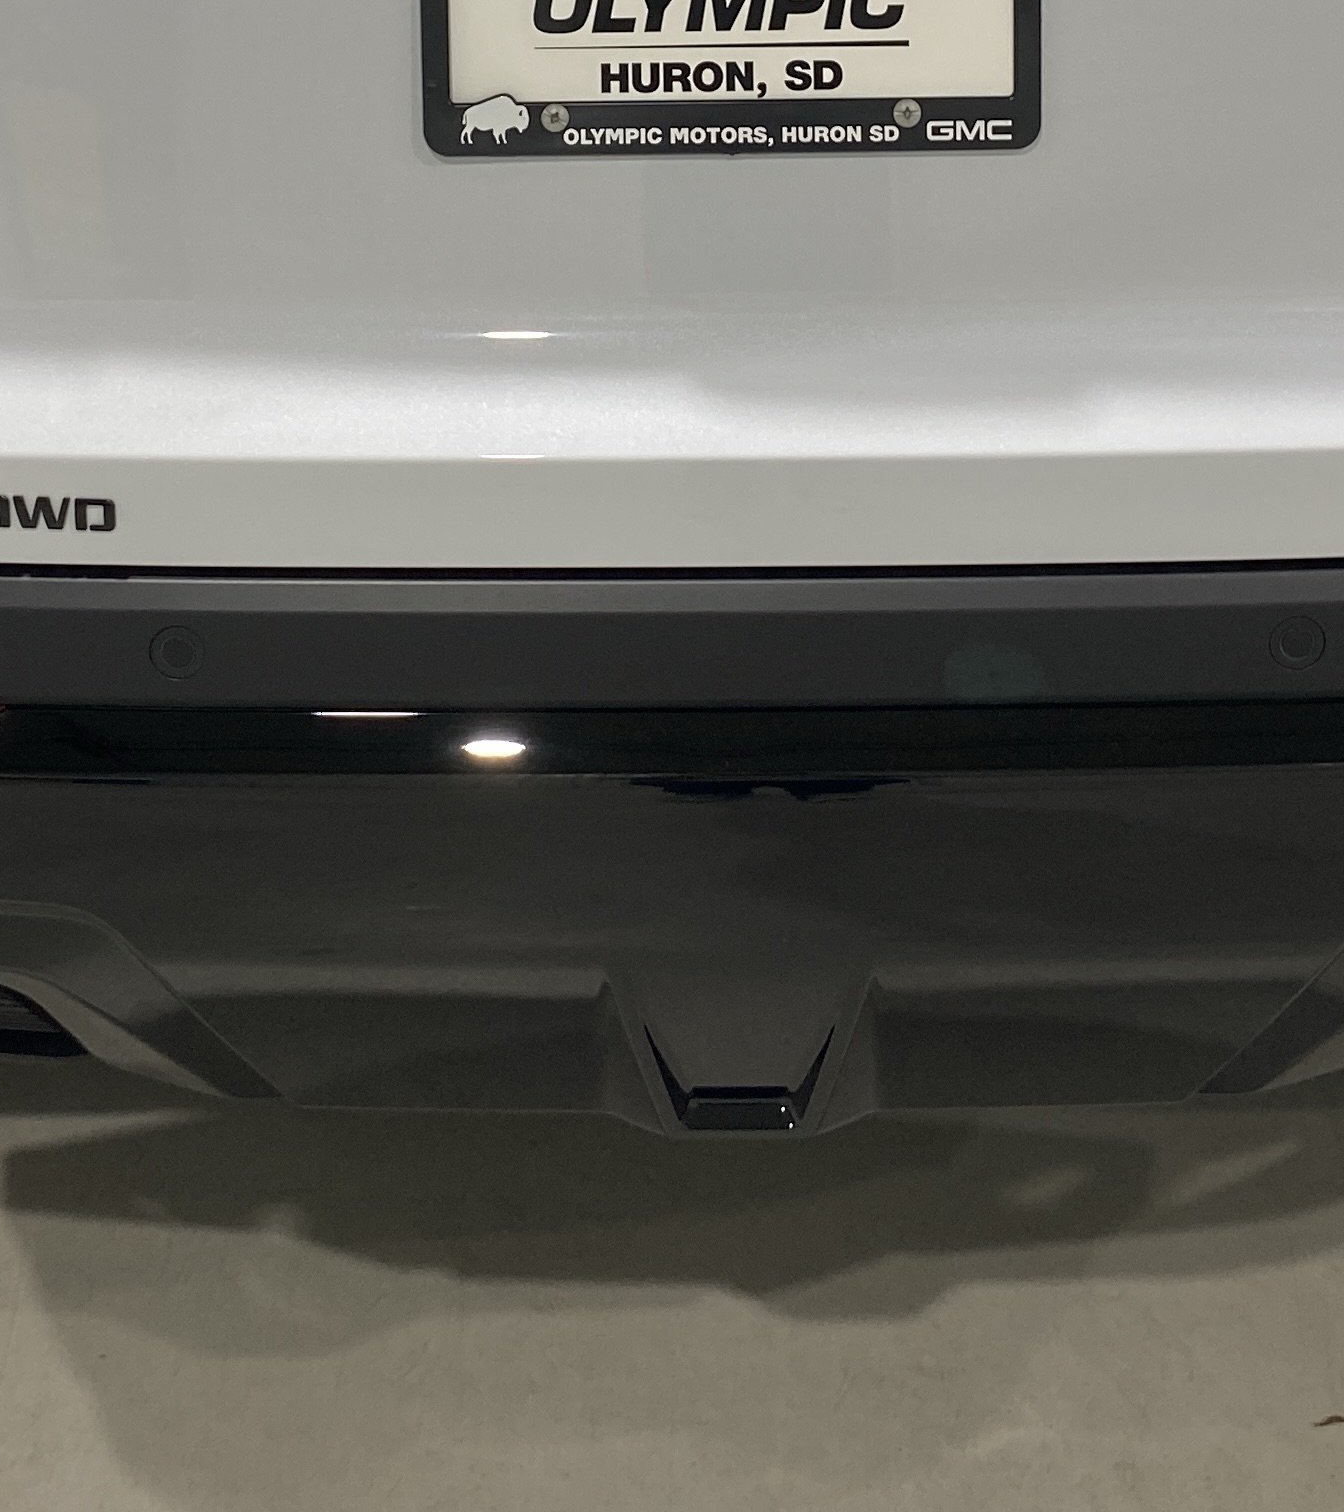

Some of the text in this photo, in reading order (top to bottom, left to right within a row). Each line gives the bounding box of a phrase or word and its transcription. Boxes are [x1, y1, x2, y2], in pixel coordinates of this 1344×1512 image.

[600, 59, 844, 99] HURON, SD
[562, 124, 900, 148] OLYMPIC MOTORS, HURON SD
[925, 118, 1014, 142] GMC
